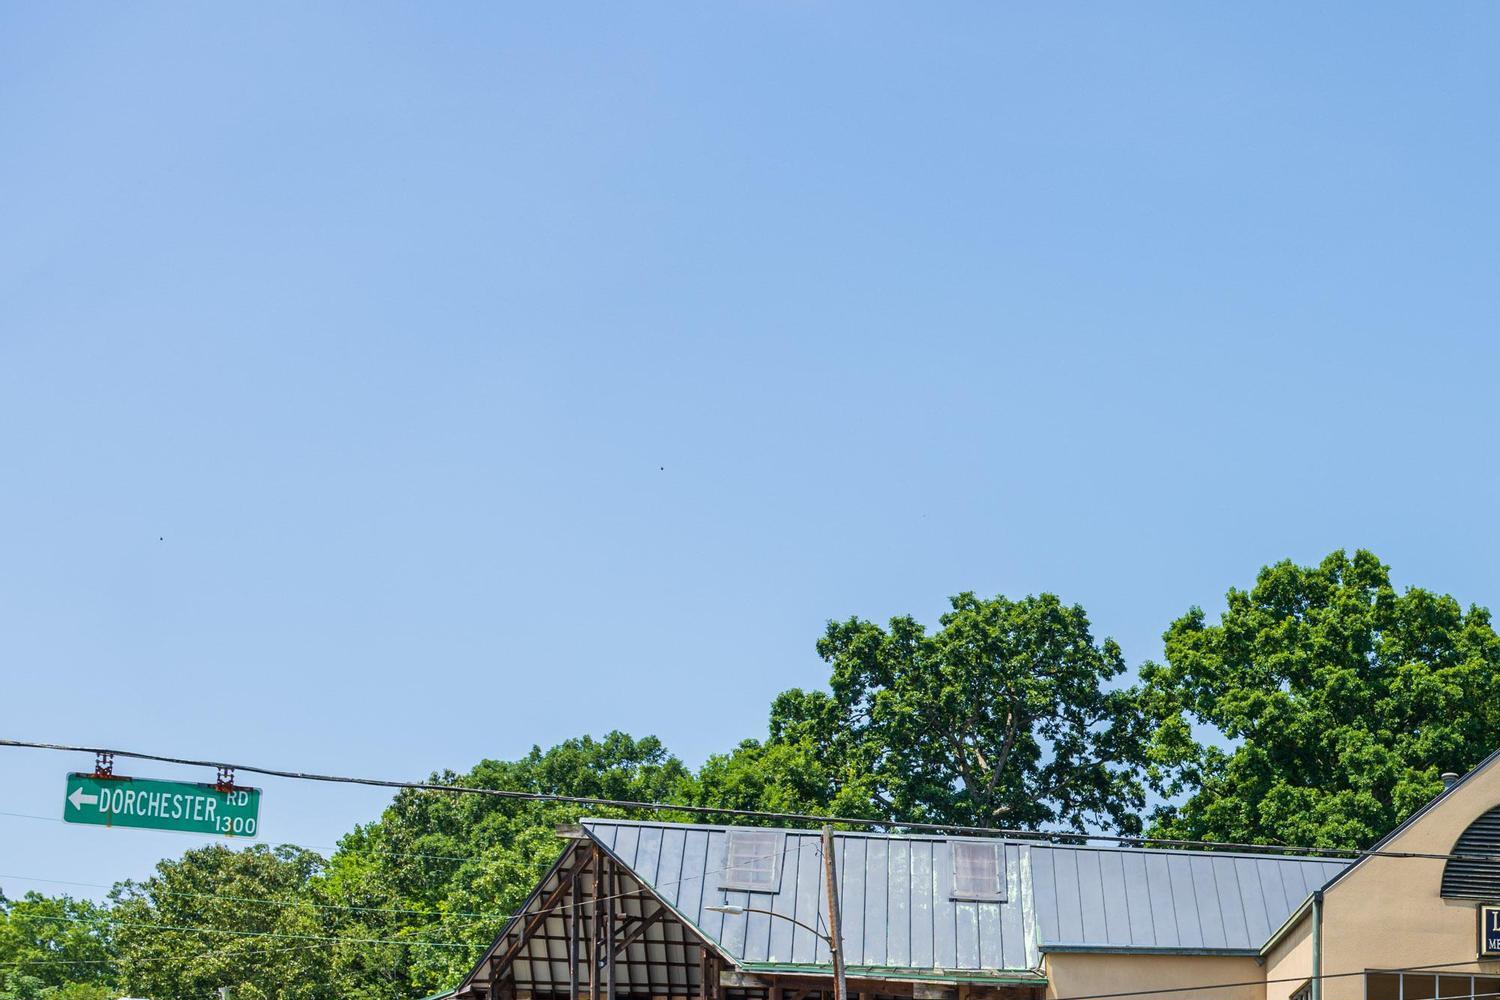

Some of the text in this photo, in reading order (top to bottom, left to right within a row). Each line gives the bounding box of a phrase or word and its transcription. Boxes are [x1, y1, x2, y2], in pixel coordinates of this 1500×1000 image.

[99, 788, 249, 822] DORCHESTER RD
[215, 815, 256, 834] 1300
